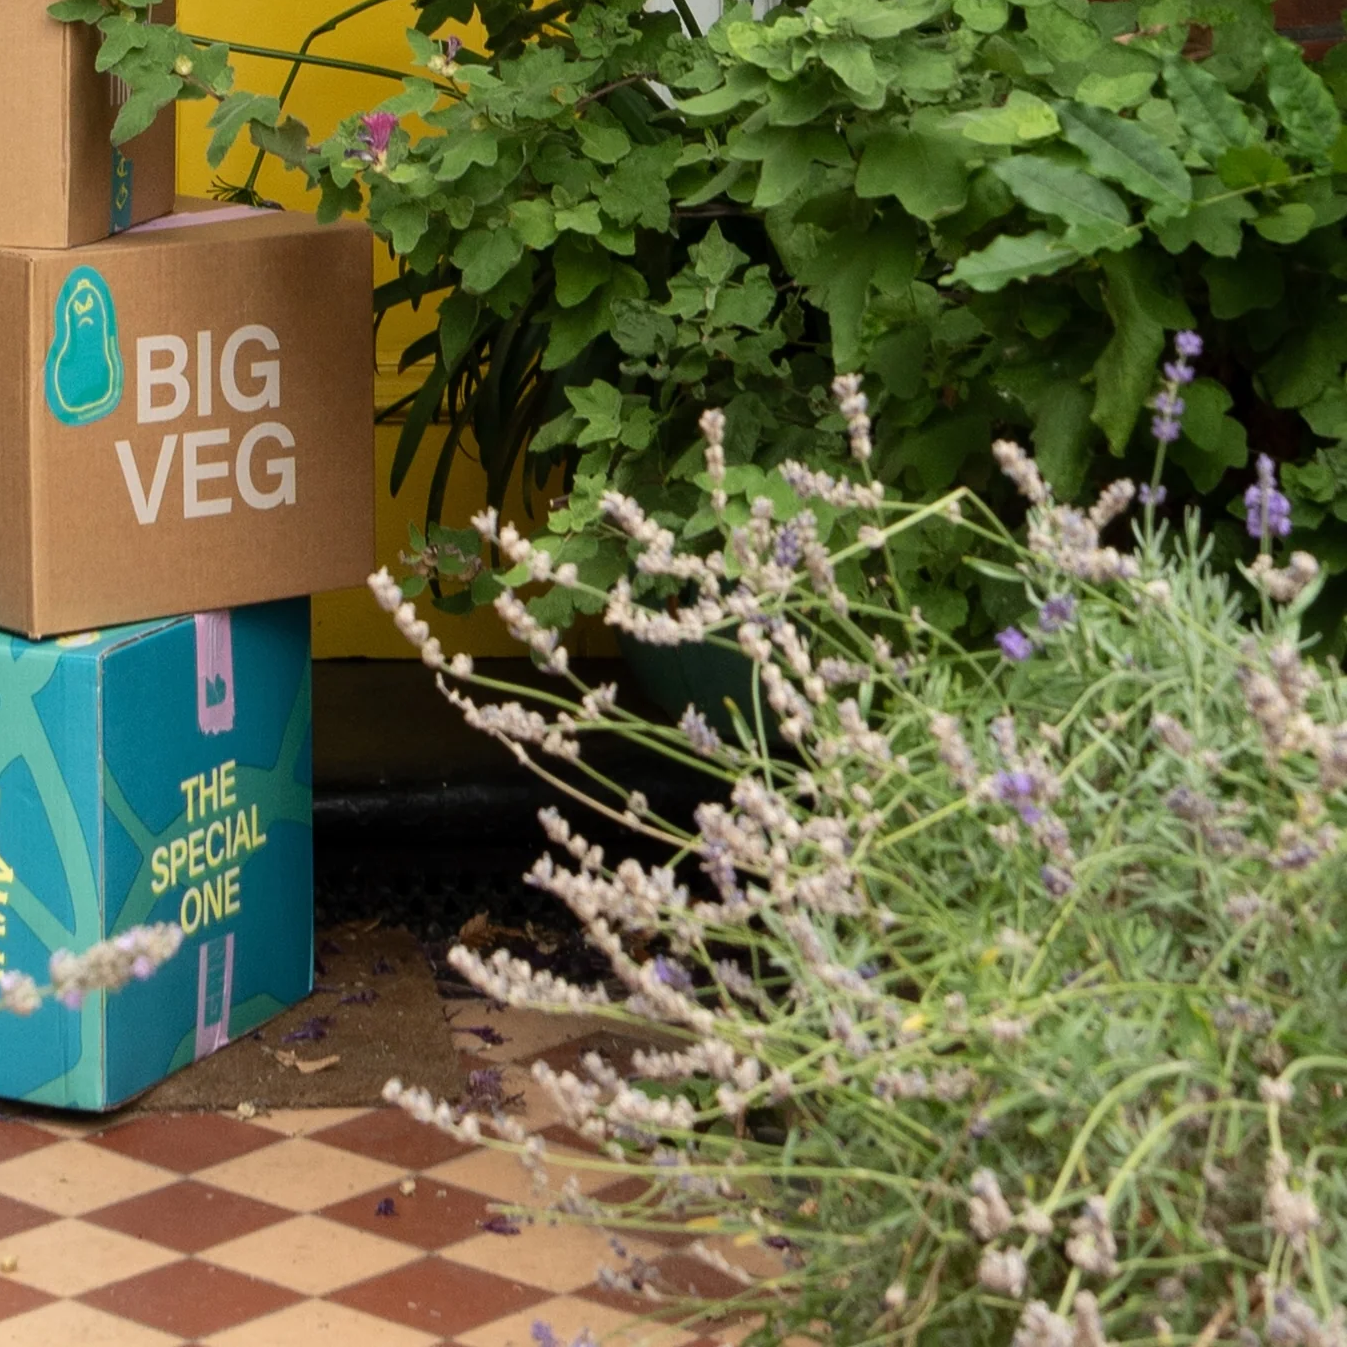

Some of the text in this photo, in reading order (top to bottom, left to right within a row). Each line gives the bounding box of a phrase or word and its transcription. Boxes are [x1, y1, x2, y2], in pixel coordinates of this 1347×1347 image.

[136, 324, 281, 424] BIG
[115, 422, 296, 525] VEG
[180, 759, 237, 822] THE
[150, 803, 267, 895] SPECIAL
[180, 867, 241, 935] ONE
